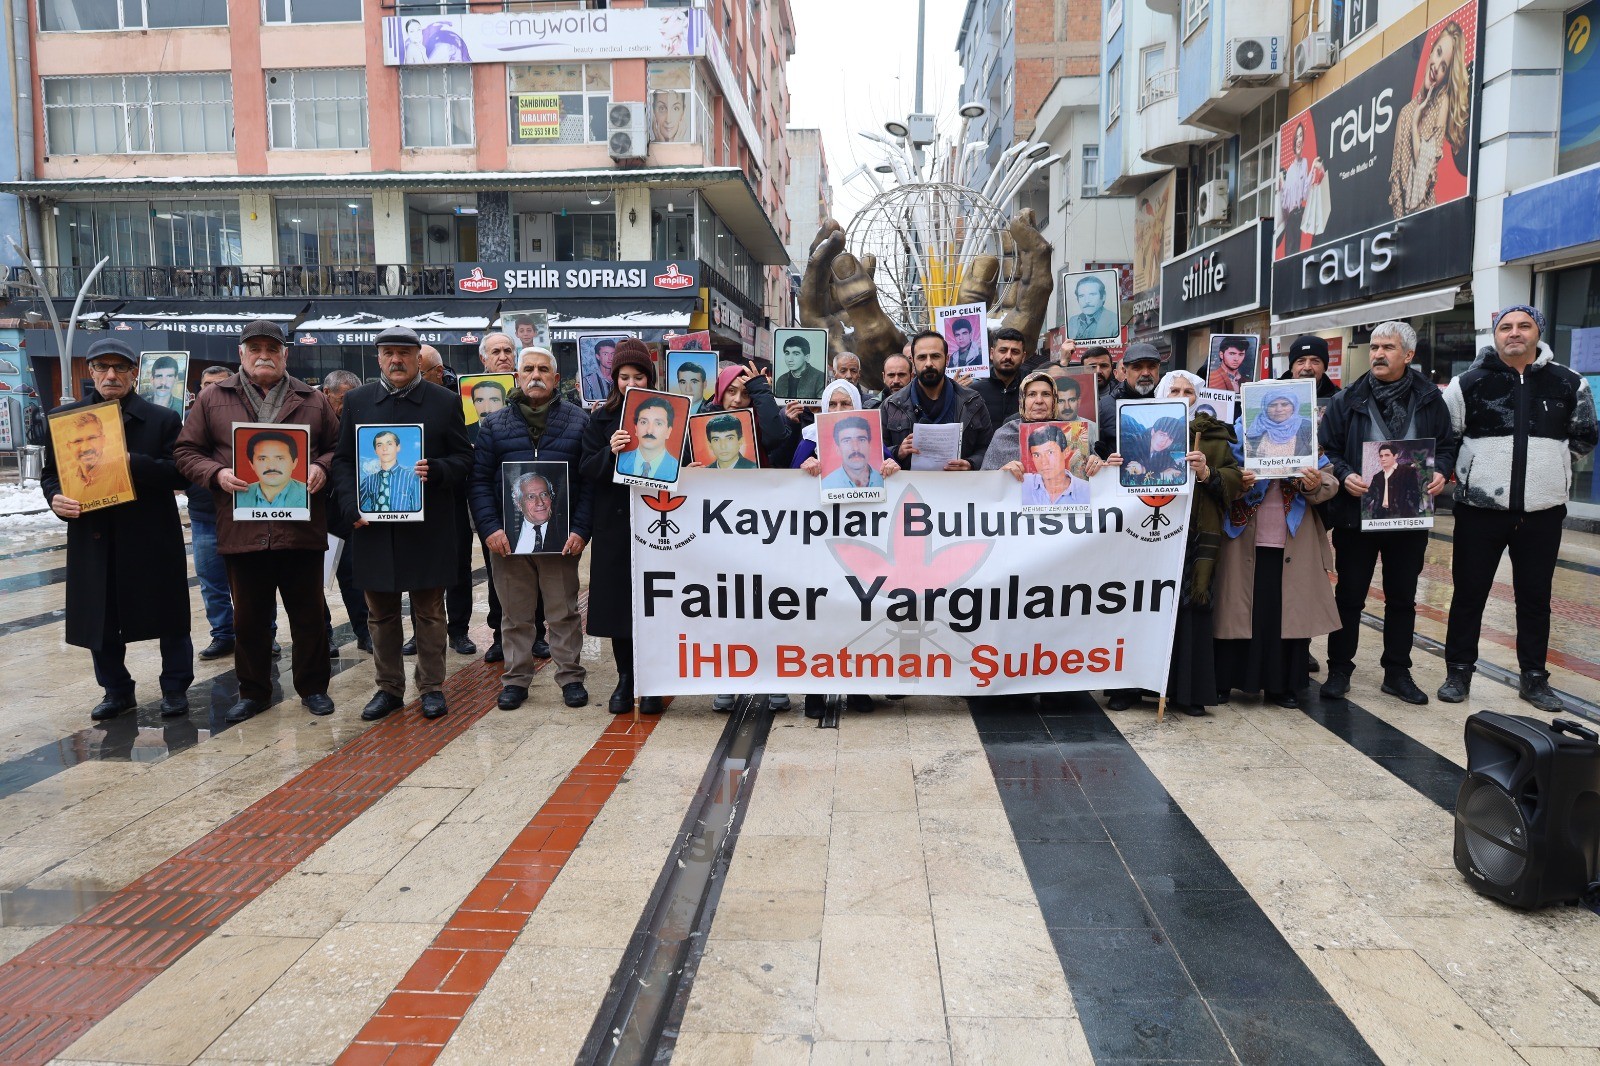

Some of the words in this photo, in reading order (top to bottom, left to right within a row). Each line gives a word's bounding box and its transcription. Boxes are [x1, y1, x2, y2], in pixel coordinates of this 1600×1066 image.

[1270, 37, 1278, 70] BEKO
[1329, 87, 1394, 159] rays
[1302, 231, 1394, 290] rays
[504, 264, 560, 293] ŞEHİR
[565, 268, 647, 289] SOFRASI
[658, 276, 689, 288] şenpiliç
[1181, 251, 1226, 302] stilife
[463, 278, 494, 290] şenpiliç
[940, 308, 957, 318] EDİP
[959, 306, 982, 316] ÇELİK
[190, 324, 246, 333] SOFRAS
[1213, 392, 1233, 402] ÇELİK
[1258, 457, 1285, 468] Taybet
[1285, 457, 1301, 466] Ana
[623, 477, 643, 486] İZZET
[644, 481, 669, 490] SEVEN
[827, 492, 845, 500] Eset
[846, 490, 880, 499] GÖKTAYI
[80, 499, 101, 511] TAHİR
[102, 494, 119, 504] ELÇİ
[251, 509, 268, 518] İSA
[271, 509, 292, 518] GÖK
[702, 499, 888, 545] Kayıplar
[903, 502, 1124, 538] Bulunsun
[1393, 518, 1425, 528] YETİŞEN
[643, 571, 828, 620] Failler
[844, 574, 1177, 634] Yargılansın
[678, 633, 758, 678] İHD
[777, 645, 951, 678] Batman
[970, 638, 1125, 688] Şubesi
